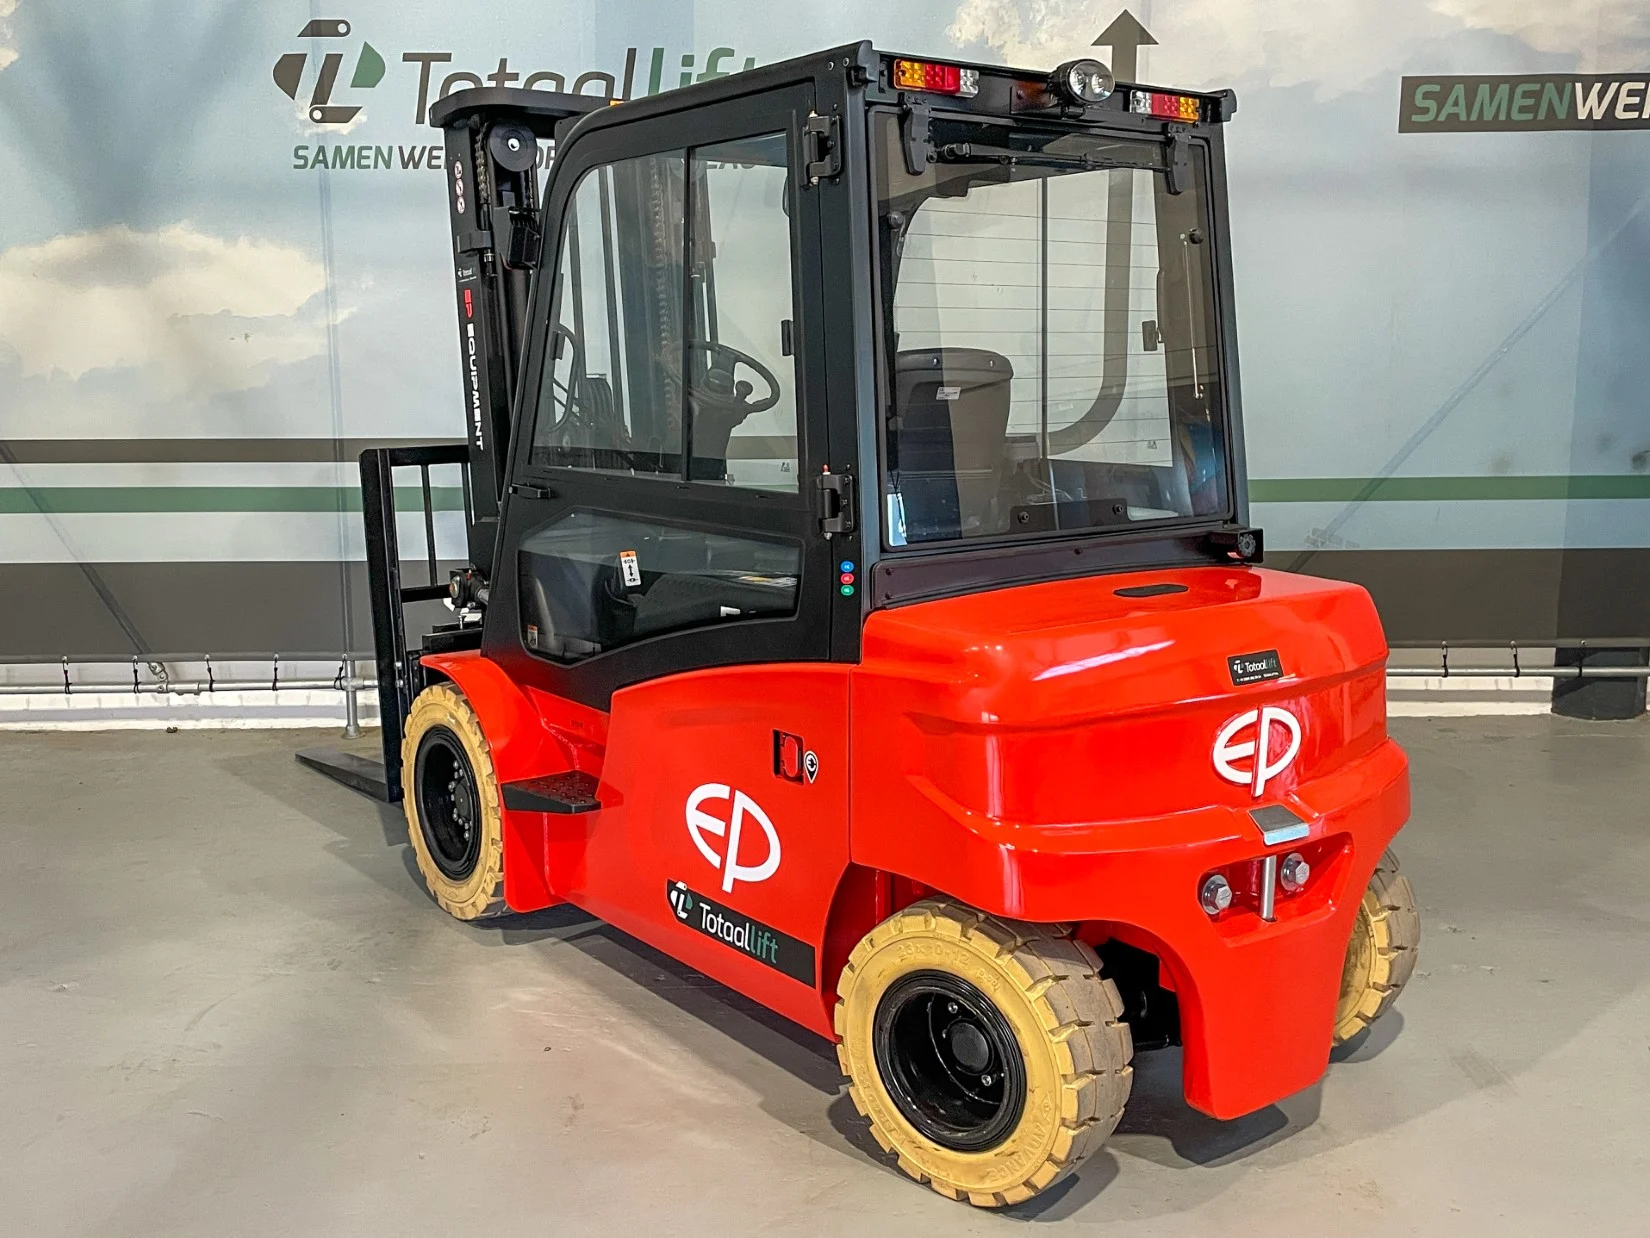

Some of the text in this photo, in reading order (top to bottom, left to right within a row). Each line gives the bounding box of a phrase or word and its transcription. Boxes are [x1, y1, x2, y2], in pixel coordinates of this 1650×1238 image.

[466, 323, 483, 451] EQUIPMENT
[1212, 706, 1302, 797] EP
[685, 782, 782, 894] EP
[699, 902, 779, 964] Totaallift
